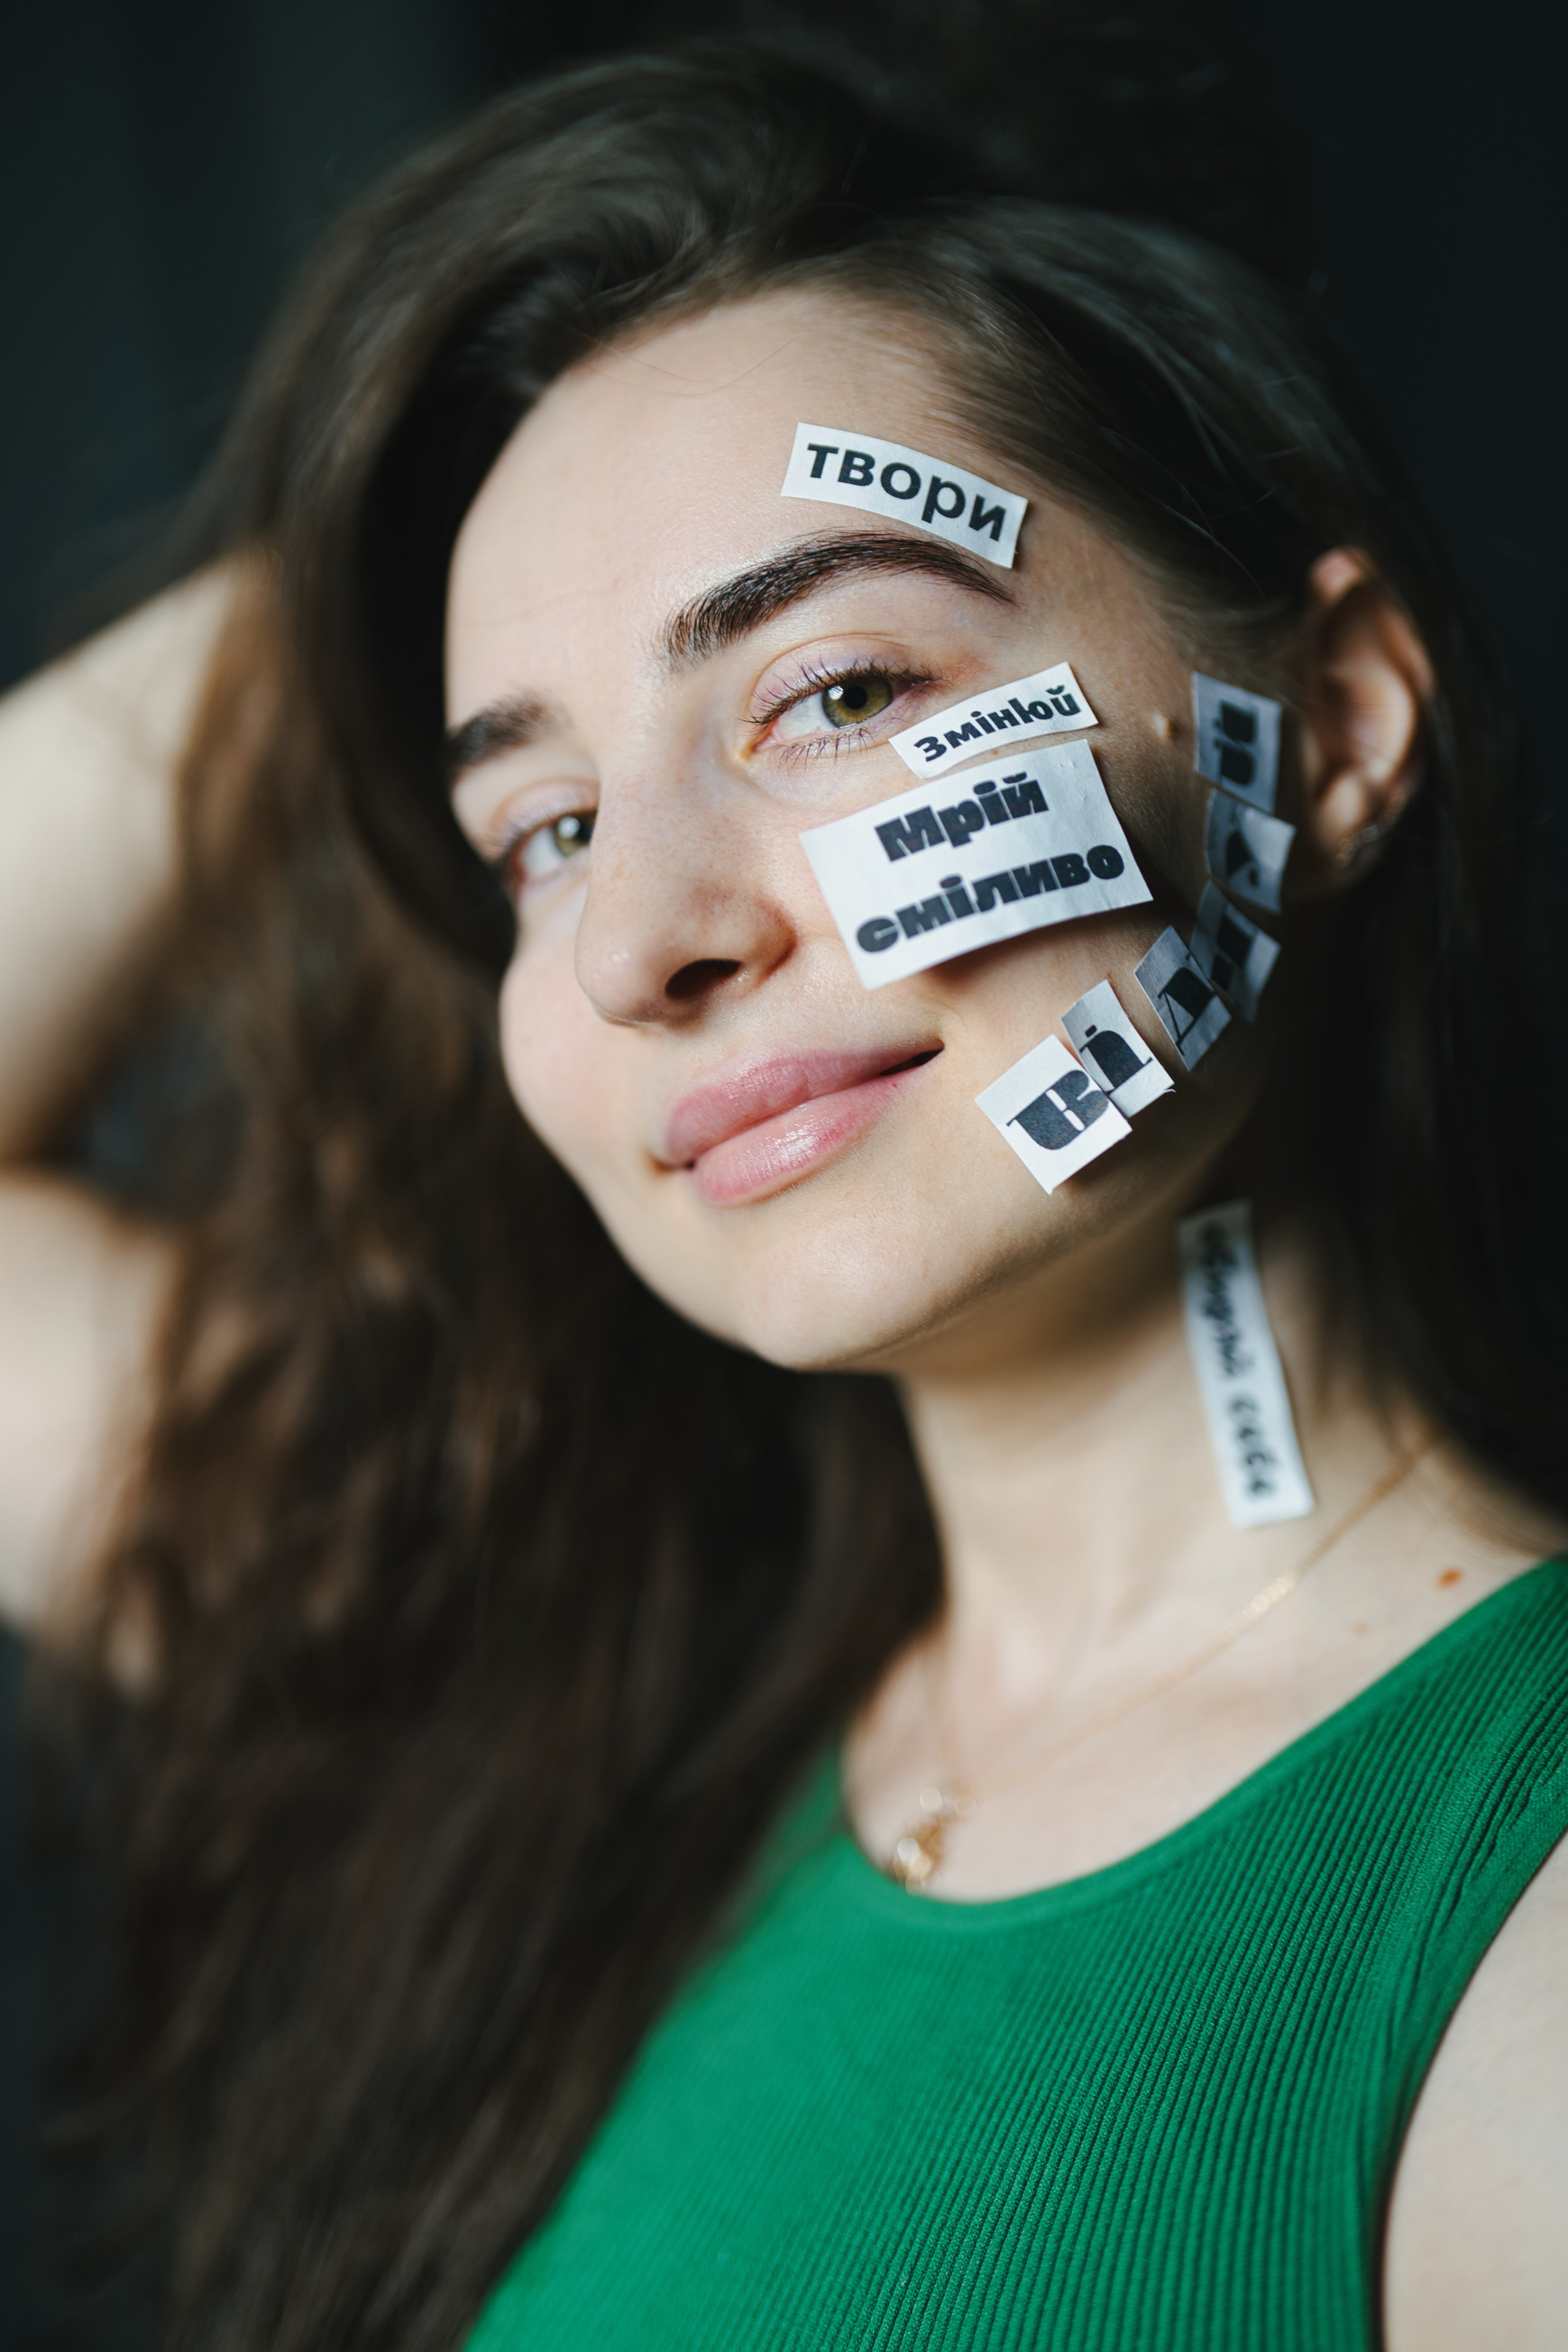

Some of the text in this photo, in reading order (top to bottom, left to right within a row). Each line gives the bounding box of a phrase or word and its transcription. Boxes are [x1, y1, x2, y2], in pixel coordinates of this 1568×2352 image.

[807, 443, 1006, 541] твори
[874, 771, 1049, 862] Мрій
[856, 843, 1125, 953] сміливо
